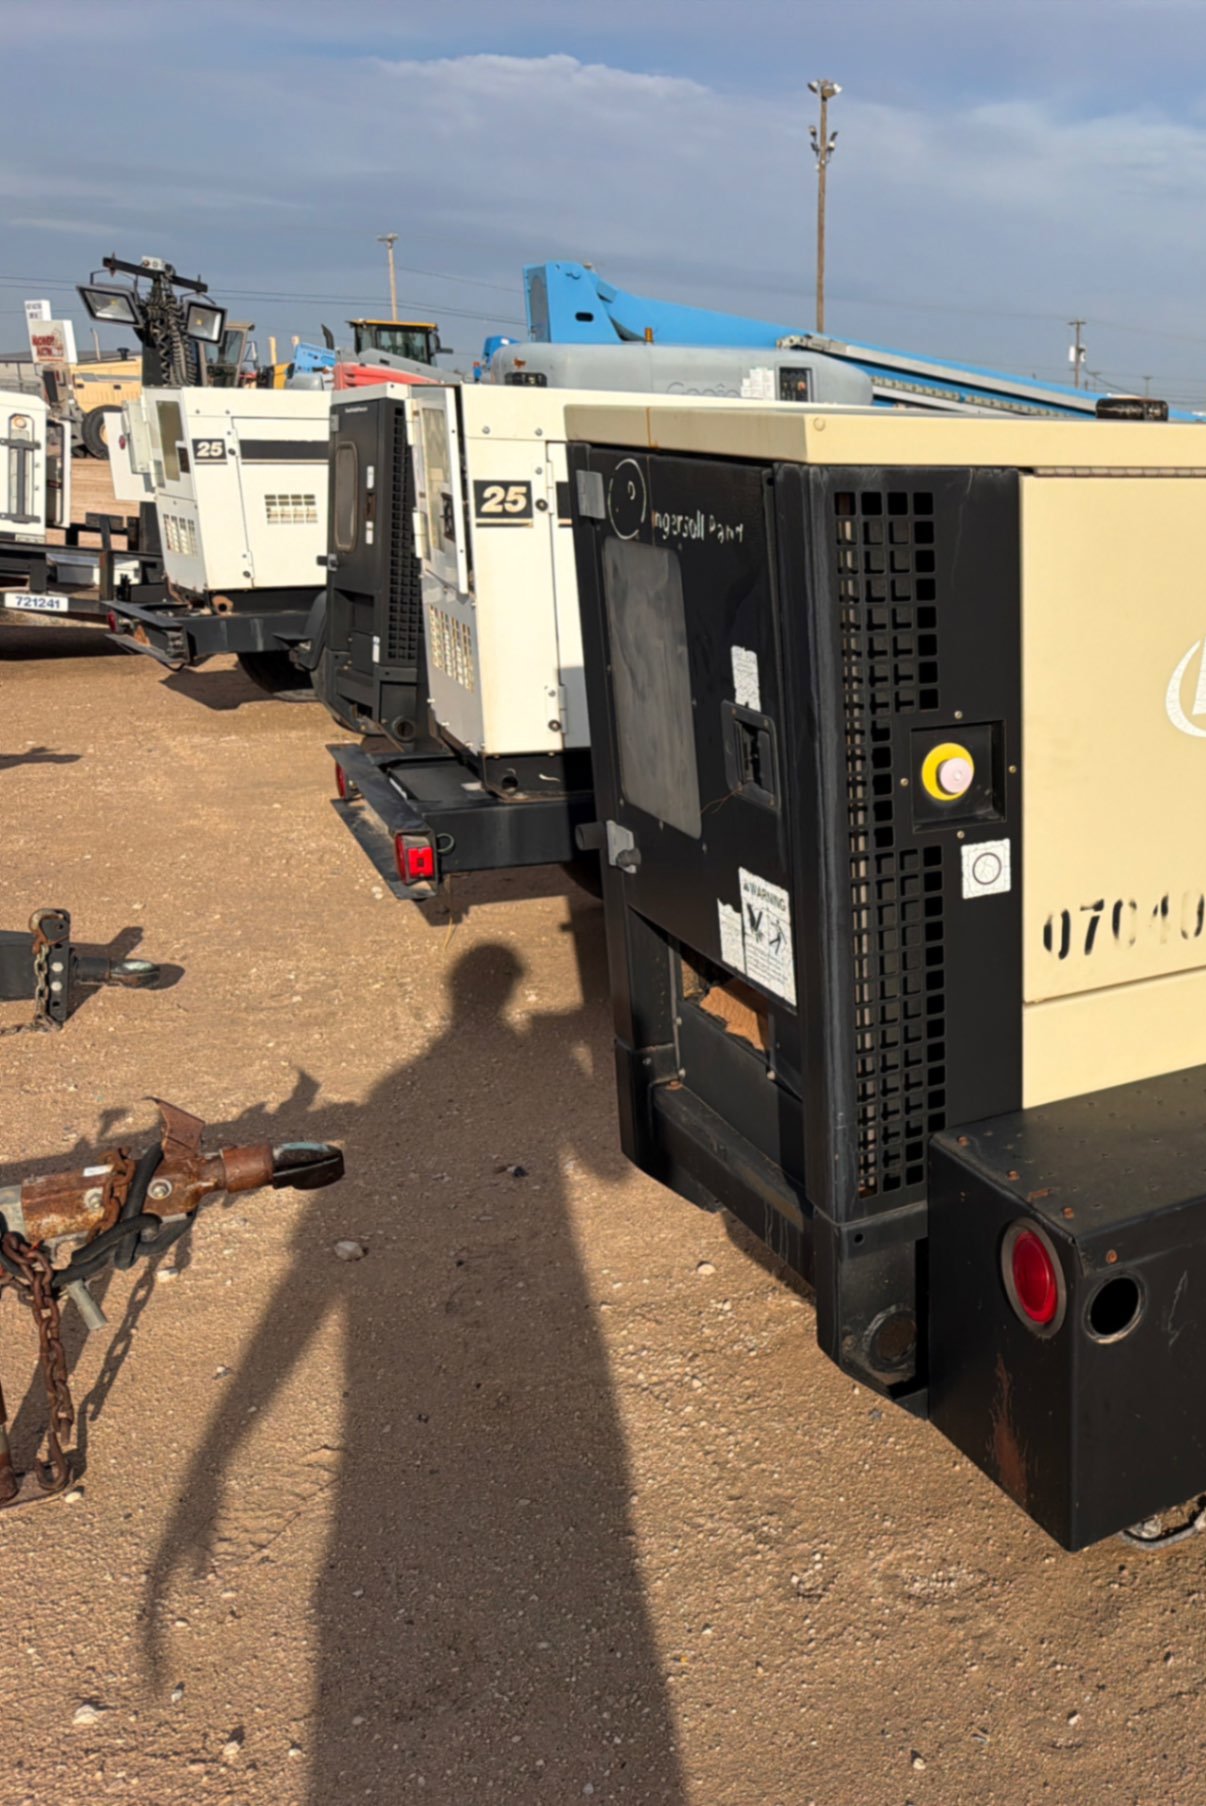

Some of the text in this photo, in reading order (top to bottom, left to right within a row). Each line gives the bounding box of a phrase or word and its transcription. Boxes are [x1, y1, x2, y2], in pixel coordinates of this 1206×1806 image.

[196, 442, 223, 457] 25
[481, 485, 528, 514] 25
[15, 595, 61, 609] 721241
